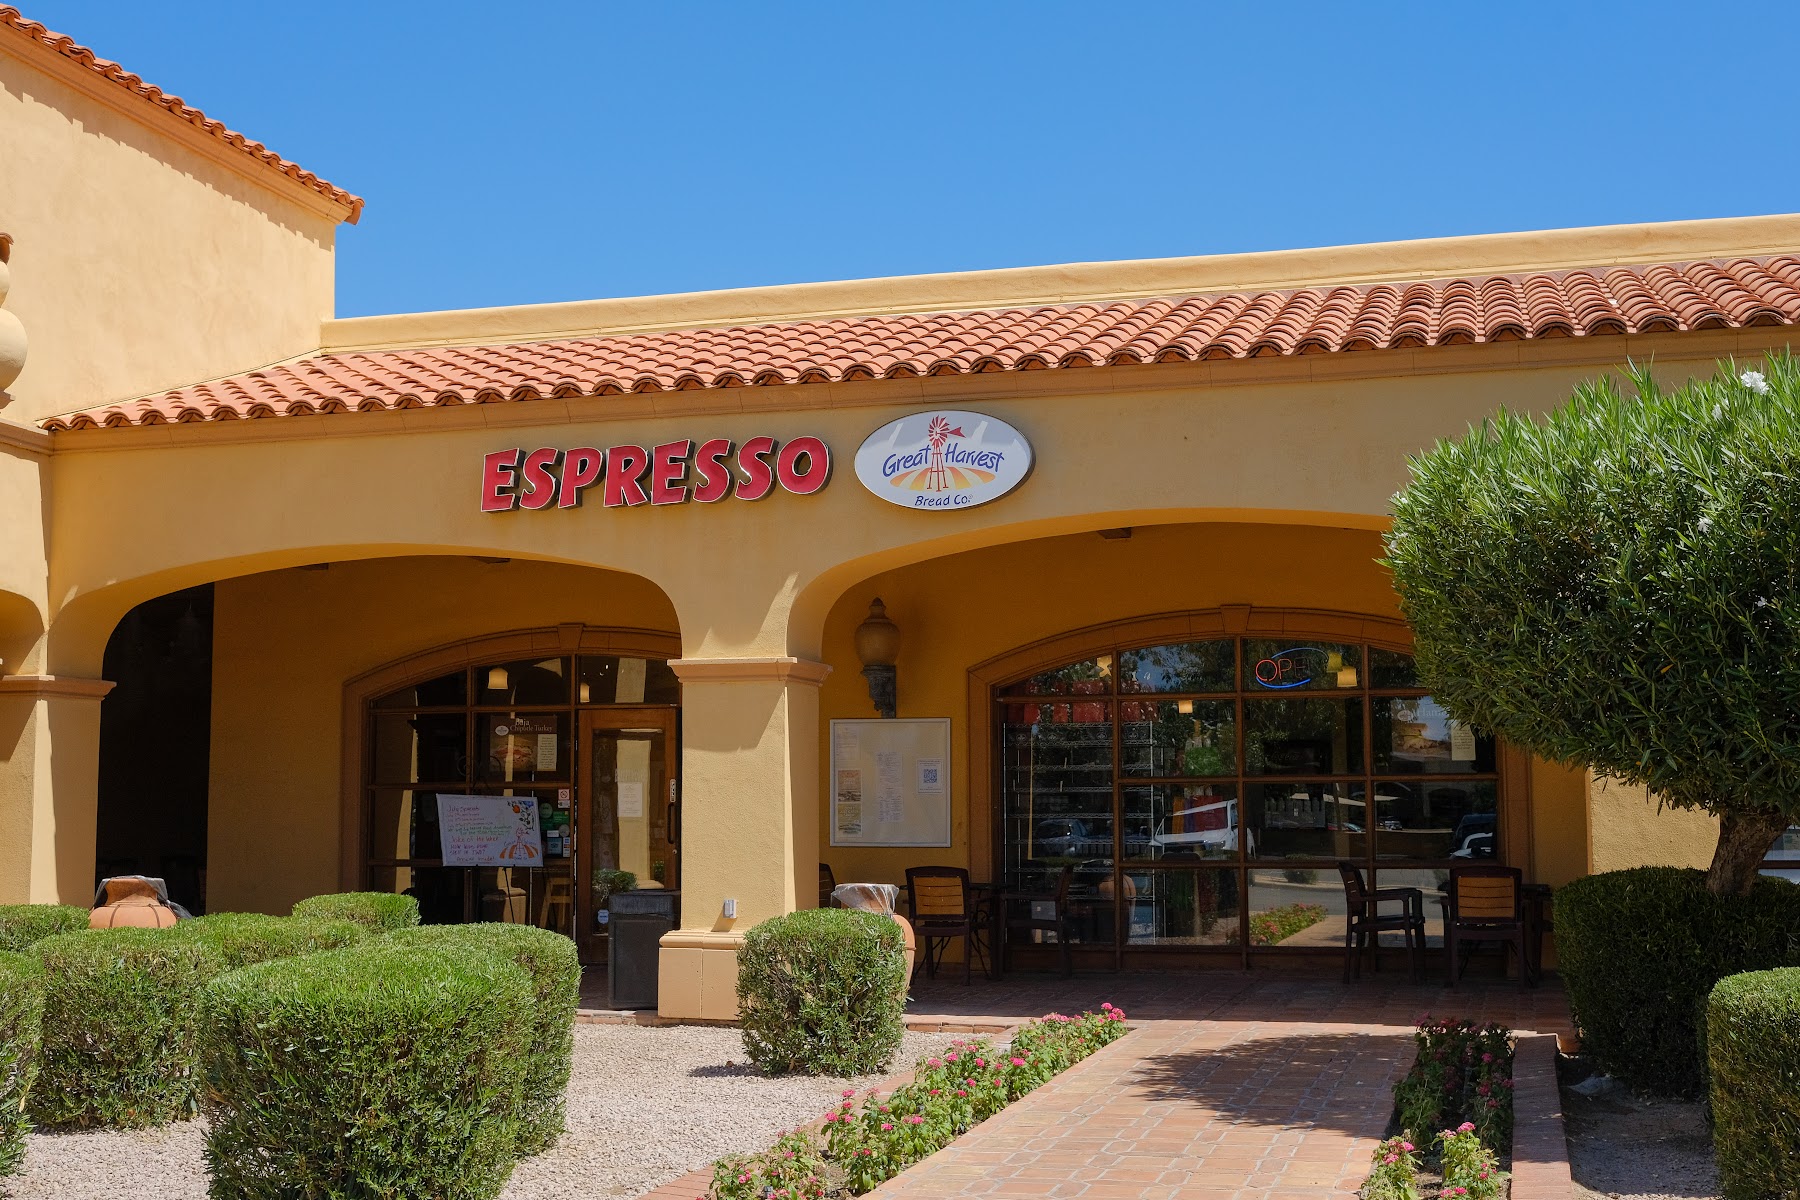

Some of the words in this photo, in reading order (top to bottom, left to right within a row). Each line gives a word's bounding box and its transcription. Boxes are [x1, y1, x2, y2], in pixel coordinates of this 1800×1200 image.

[883, 444, 931, 477] Great
[944, 443, 1005, 472] Harvest
[481, 436, 831, 512] ESPRESSO
[915, 495, 950, 506] Bread
[510, 725, 534, 733] Chipotle
[535, 725, 552, 733] Turkey
